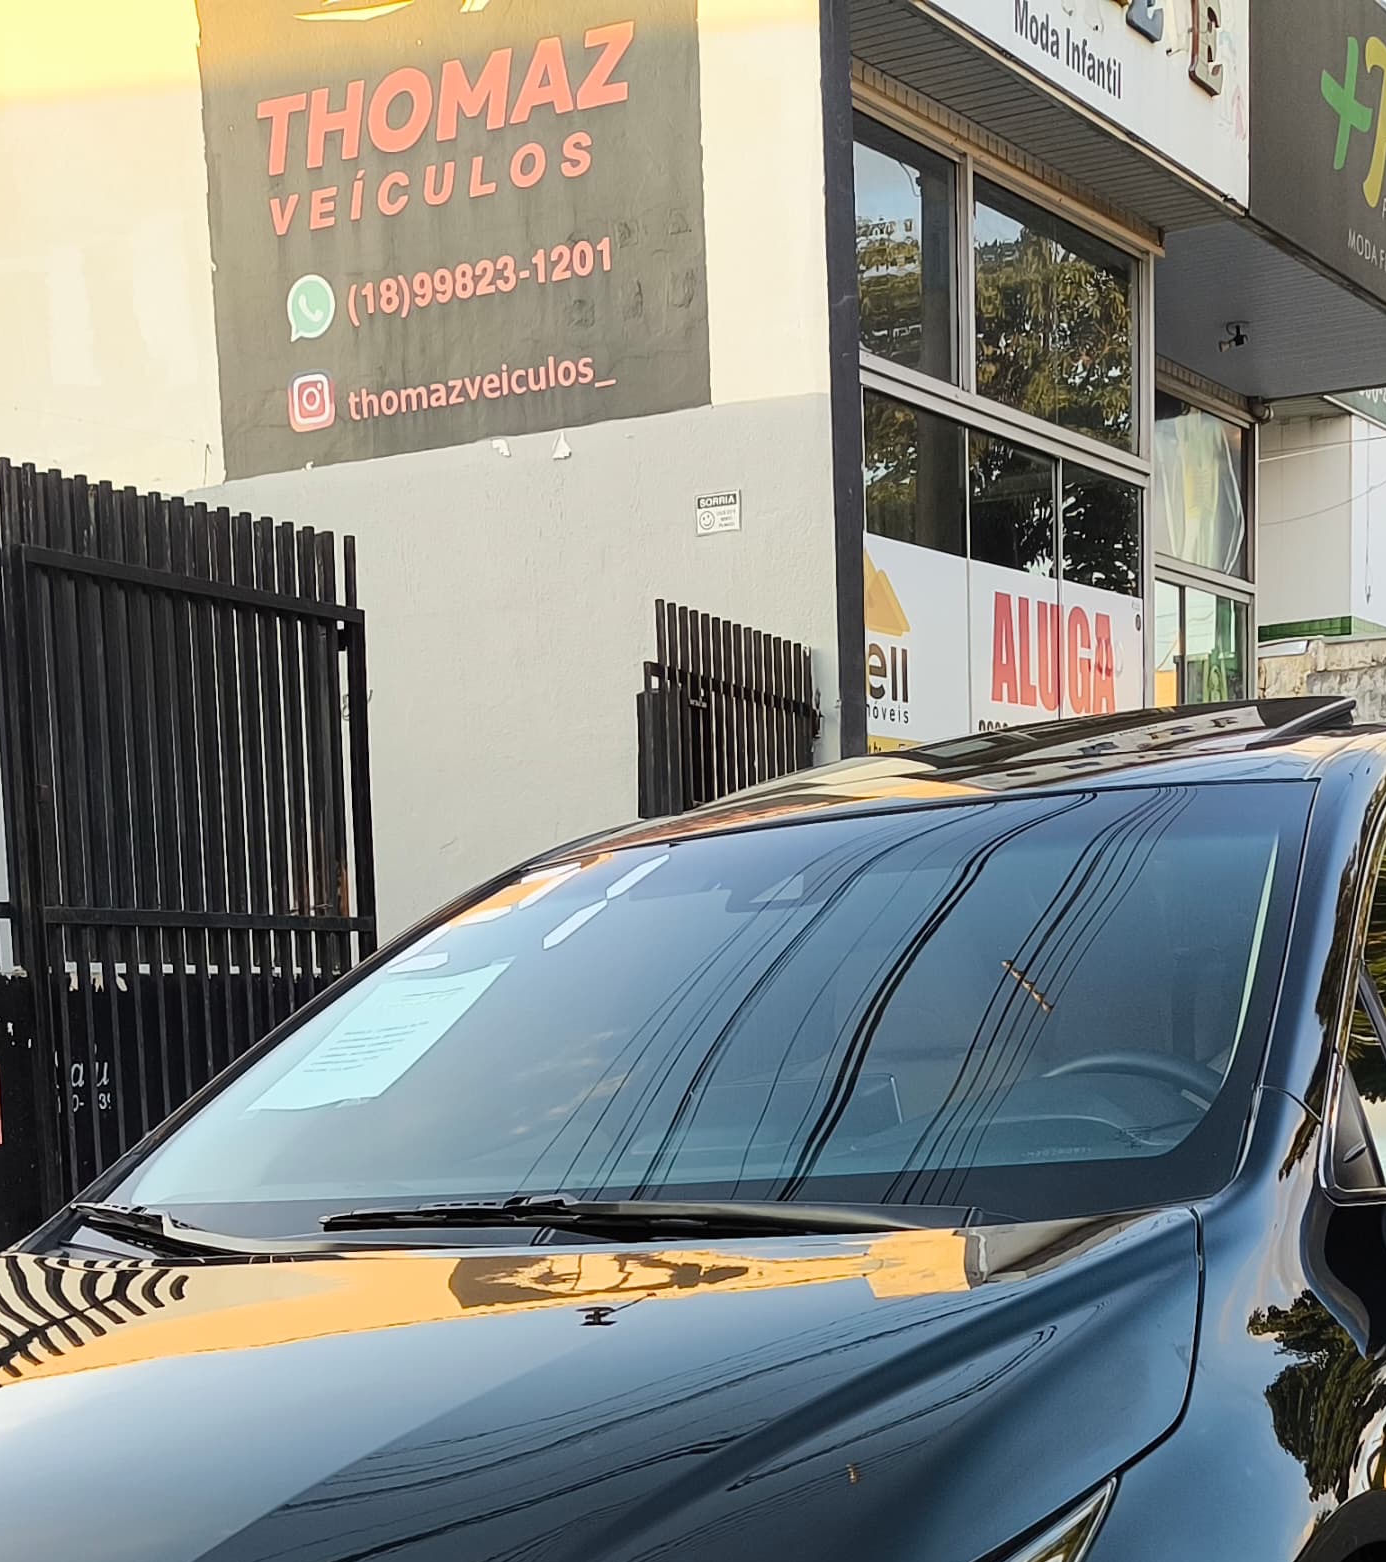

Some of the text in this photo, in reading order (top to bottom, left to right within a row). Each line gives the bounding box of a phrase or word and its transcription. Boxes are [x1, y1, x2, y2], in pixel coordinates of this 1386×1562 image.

[1014, 0, 1061, 60] Moda
[1065, 28, 1122, 99] Infantil
[256, 21, 635, 177] THOMAZ
[269, 131, 593, 236] VEÍCULOS
[347, 236, 612, 327] (18)99823-1201
[1348, 228, 1378, 266] MODA
[348, 356, 616, 421] thomazveiculos_
[699, 495, 735, 508] SORRIA
[991, 591, 1116, 714] ALUGA
